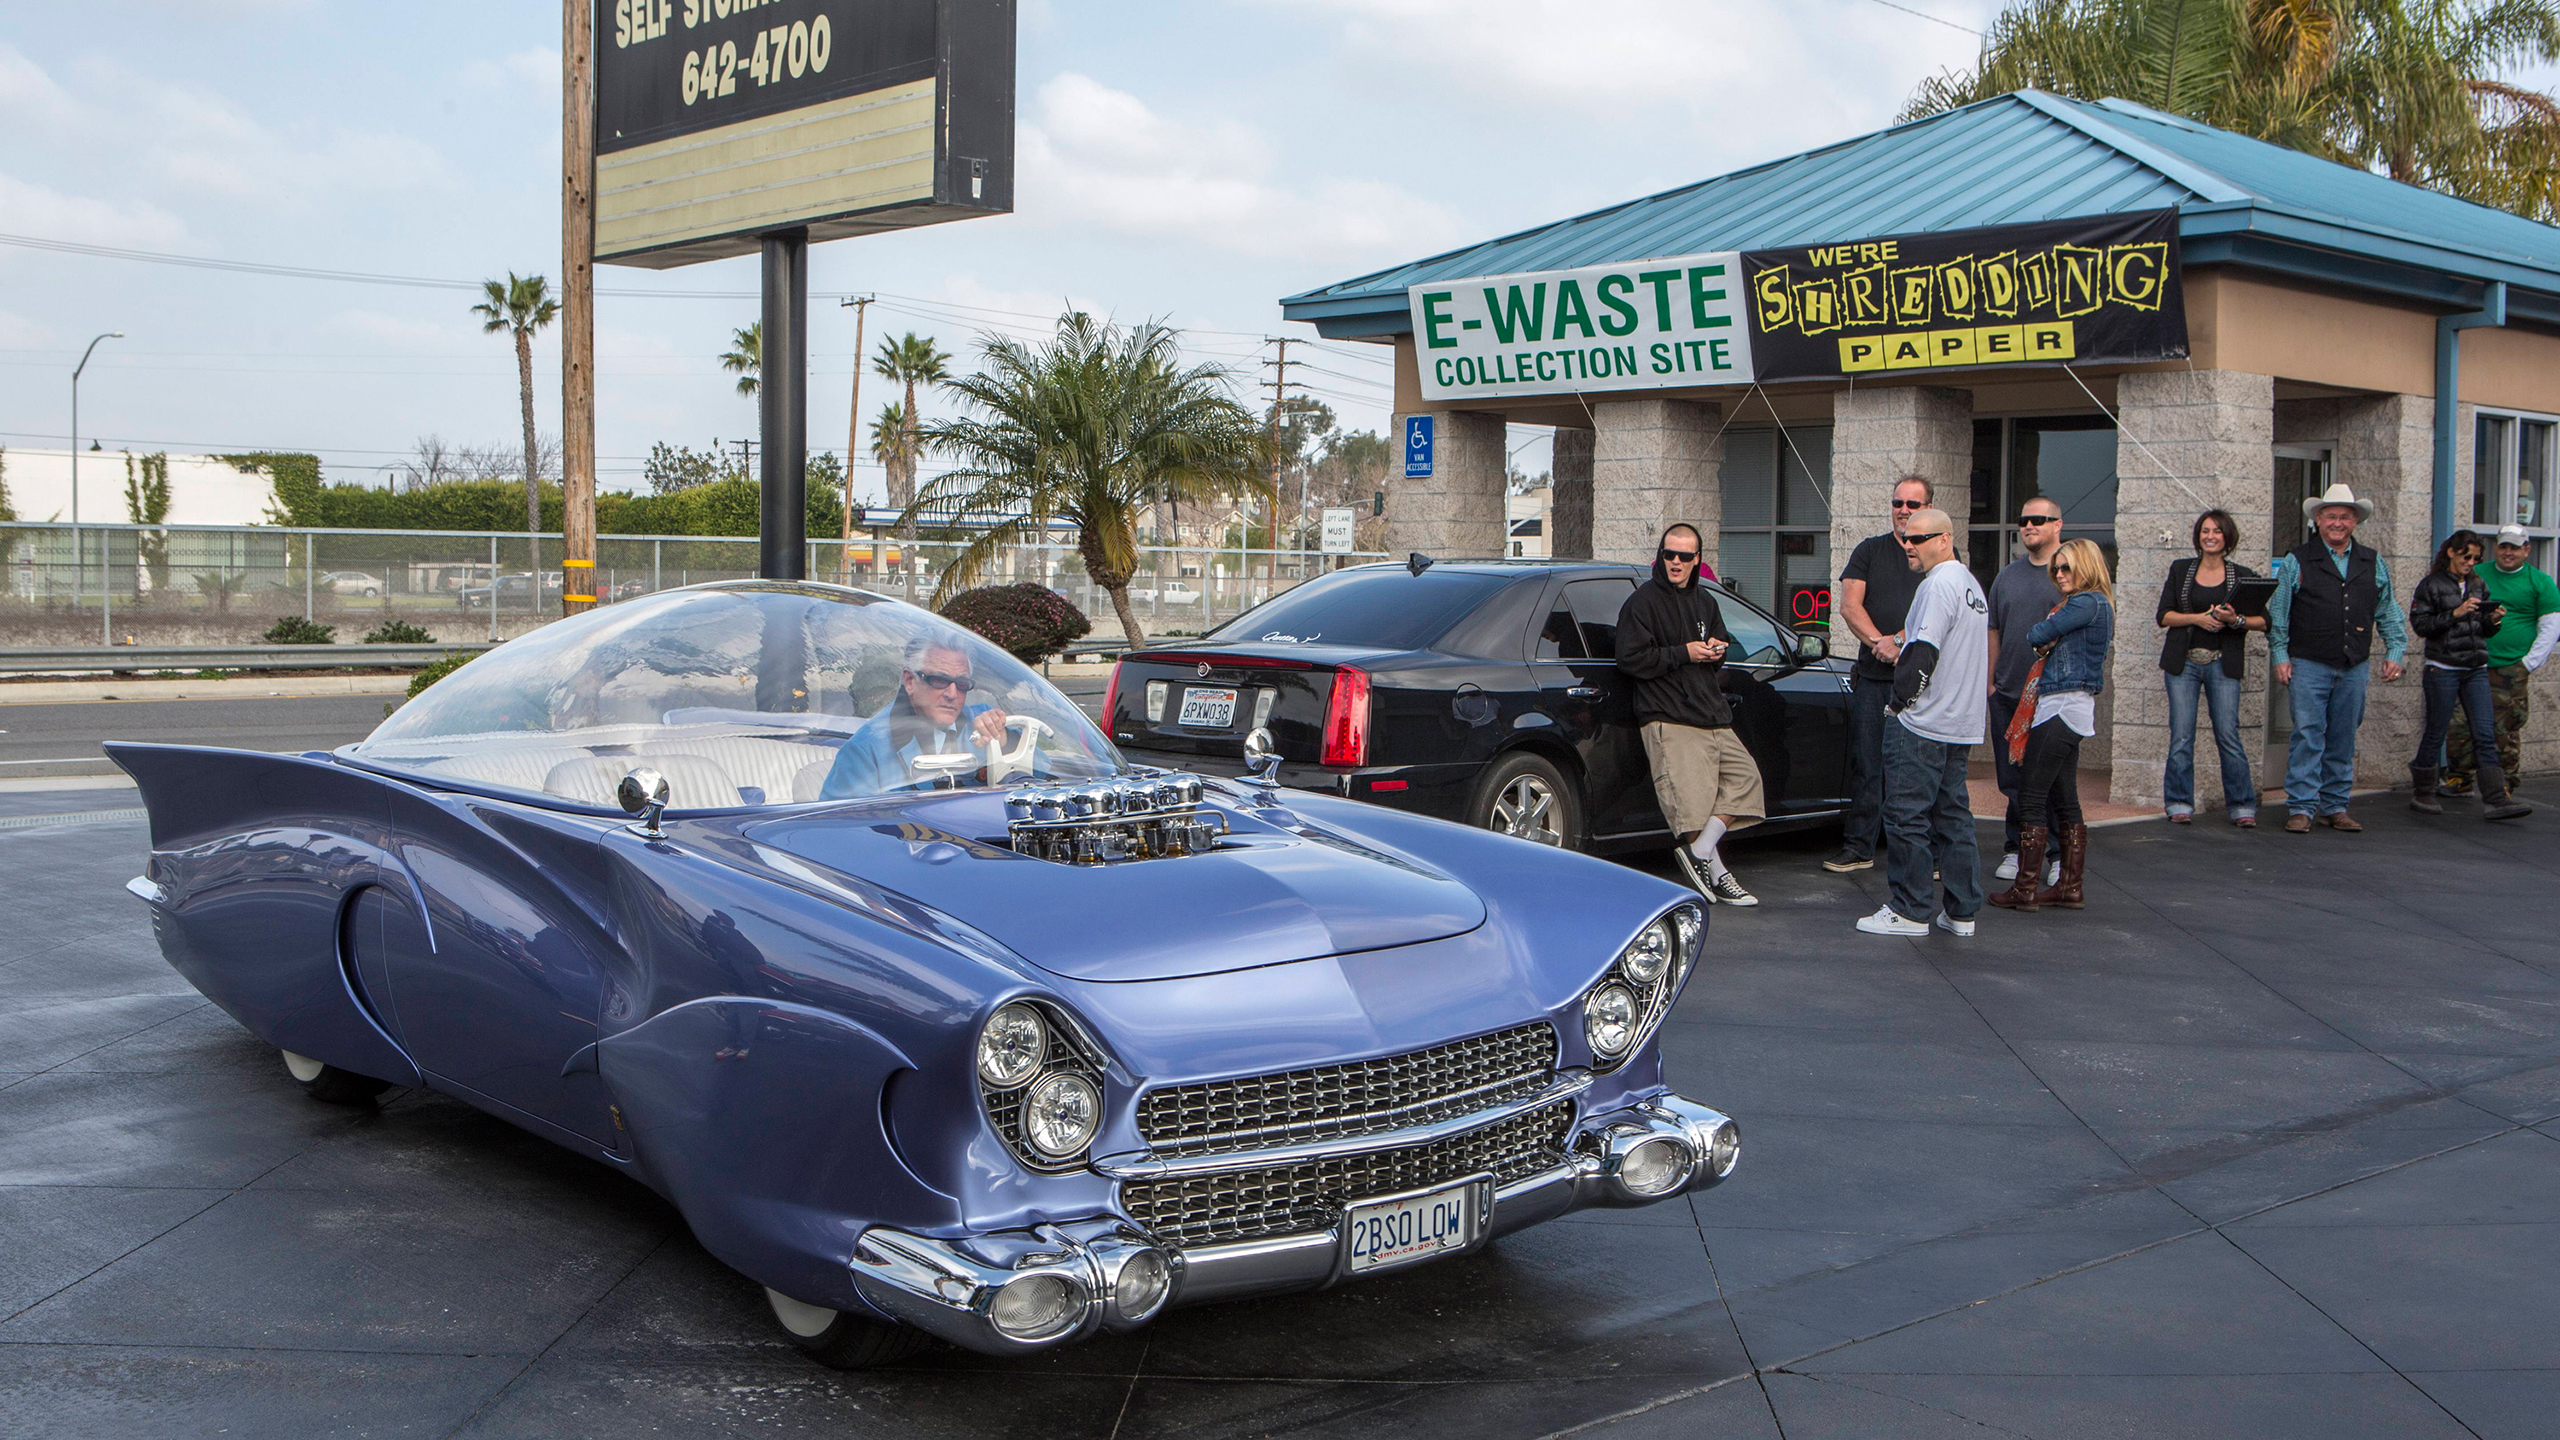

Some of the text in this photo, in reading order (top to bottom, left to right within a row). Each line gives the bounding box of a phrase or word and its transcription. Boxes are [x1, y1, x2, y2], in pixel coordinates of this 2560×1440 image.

[616, 0, 672, 49] SELF
[682, 14, 831, 106] 642-4700
[1808, 241, 1900, 267] WE'RE
[1758, 251, 2156, 326] SHREDDING
[1422, 264, 1732, 349] E-WASTE
[1851, 330, 2063, 363] PAPER
[1435, 339, 1732, 387] COLLECTION SITE
[1406, 463, 1431, 471] ACCESSIBLE
[1414, 453, 1425, 461] VAN
[1327, 527, 1347, 536] MUST
[1793, 590, 1831, 619] OP
[1184, 702, 1230, 720] 6PXW038
[1377, 1241, 1436, 1259] dmv.ca.gov
